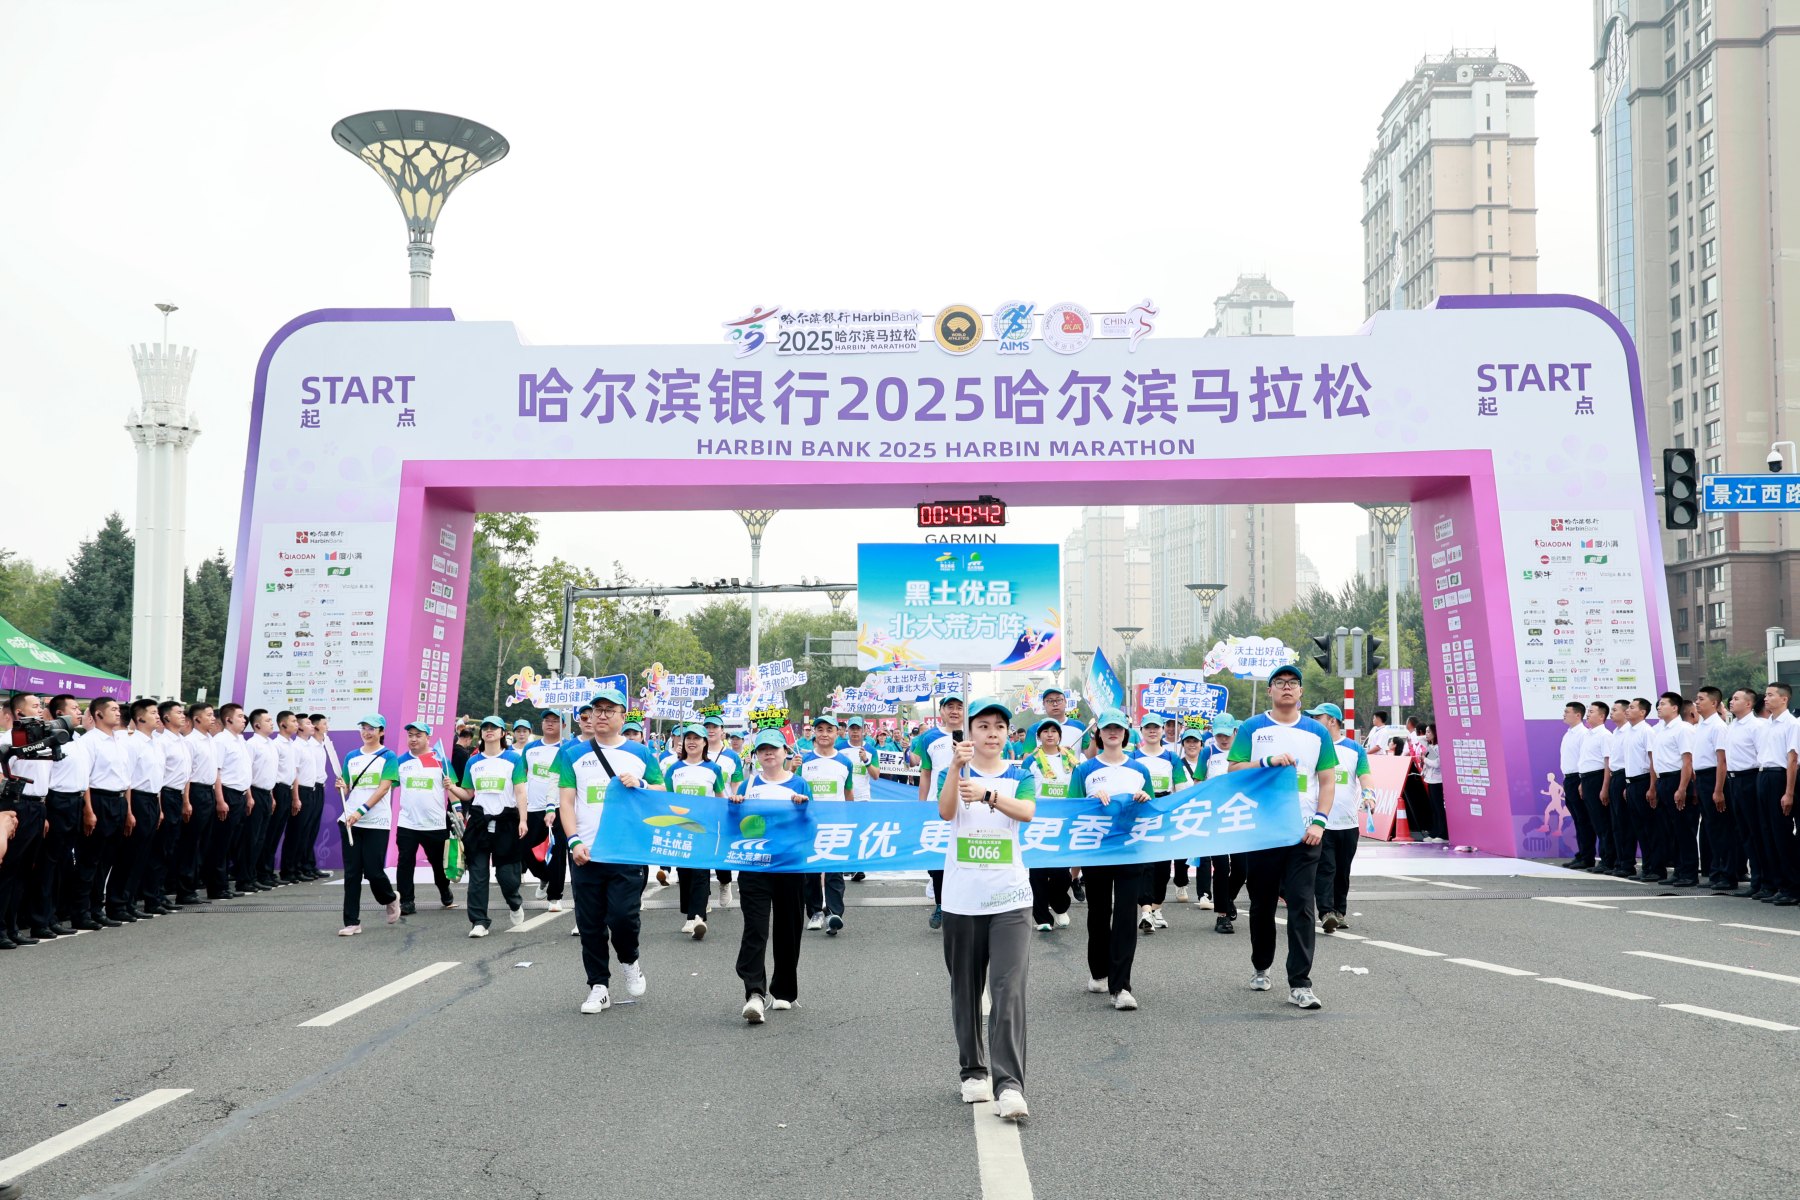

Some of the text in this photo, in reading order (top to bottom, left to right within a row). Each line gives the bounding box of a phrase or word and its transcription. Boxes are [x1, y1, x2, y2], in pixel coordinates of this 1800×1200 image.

[780, 311, 919, 325] 哈尔滨银行 HarbinBank
[1103, 317, 1134, 326] CHINA
[778, 329, 917, 352] 2025 哈尔滨马拉松
[870, 343, 917, 351] MARATHON
[999, 341, 1030, 351] AIMS
[1477, 362, 1592, 393] START
[301, 375, 416, 406] START
[517, 361, 1372, 427] 哈尔滨银行2025哈尔滨马拉松
[697, 438, 1196, 458] HARBIN BANK 2025 HARBIN MARATHON
[920, 504, 1001, 525] 00:49:42
[925, 533, 997, 544] GARMIN
[284, 553, 316, 561] QIAODAN
[904, 579, 1012, 606] 黑土优品
[888, 612, 1024, 640] 北大荒方阵
[1234, 645, 1285, 656] 沃土出好品
[758, 659, 793, 679] 奔跑吧
[539, 677, 586, 691] 黑土能量
[667, 675, 704, 685] 黑土能量
[884, 673, 927, 684] 沃土出好品
[670, 686, 708, 697] 跑向健康
[887, 682, 931, 693] 健康北大荒
[545, 690, 592, 703] 跑向健康
[1144, 696, 1212, 708] 更香 更安全
[847, 703, 898, 714] 骄傲的少年
[22, 742, 45, 753] RONIN
[537, 768, 549, 776] 004
[480, 781, 498, 789] 0013
[813, 785, 831, 794] 0002
[806, 821, 902, 863] 更优
[1022, 814, 1113, 852] 更香
[1124, 792, 1259, 846] 更安全
[652, 835, 693, 851] 黑土优品
[650, 846, 691, 859] PREMIUM
[726, 850, 772, 863] 北大荒集团
[968, 845, 1001, 860] 0066
